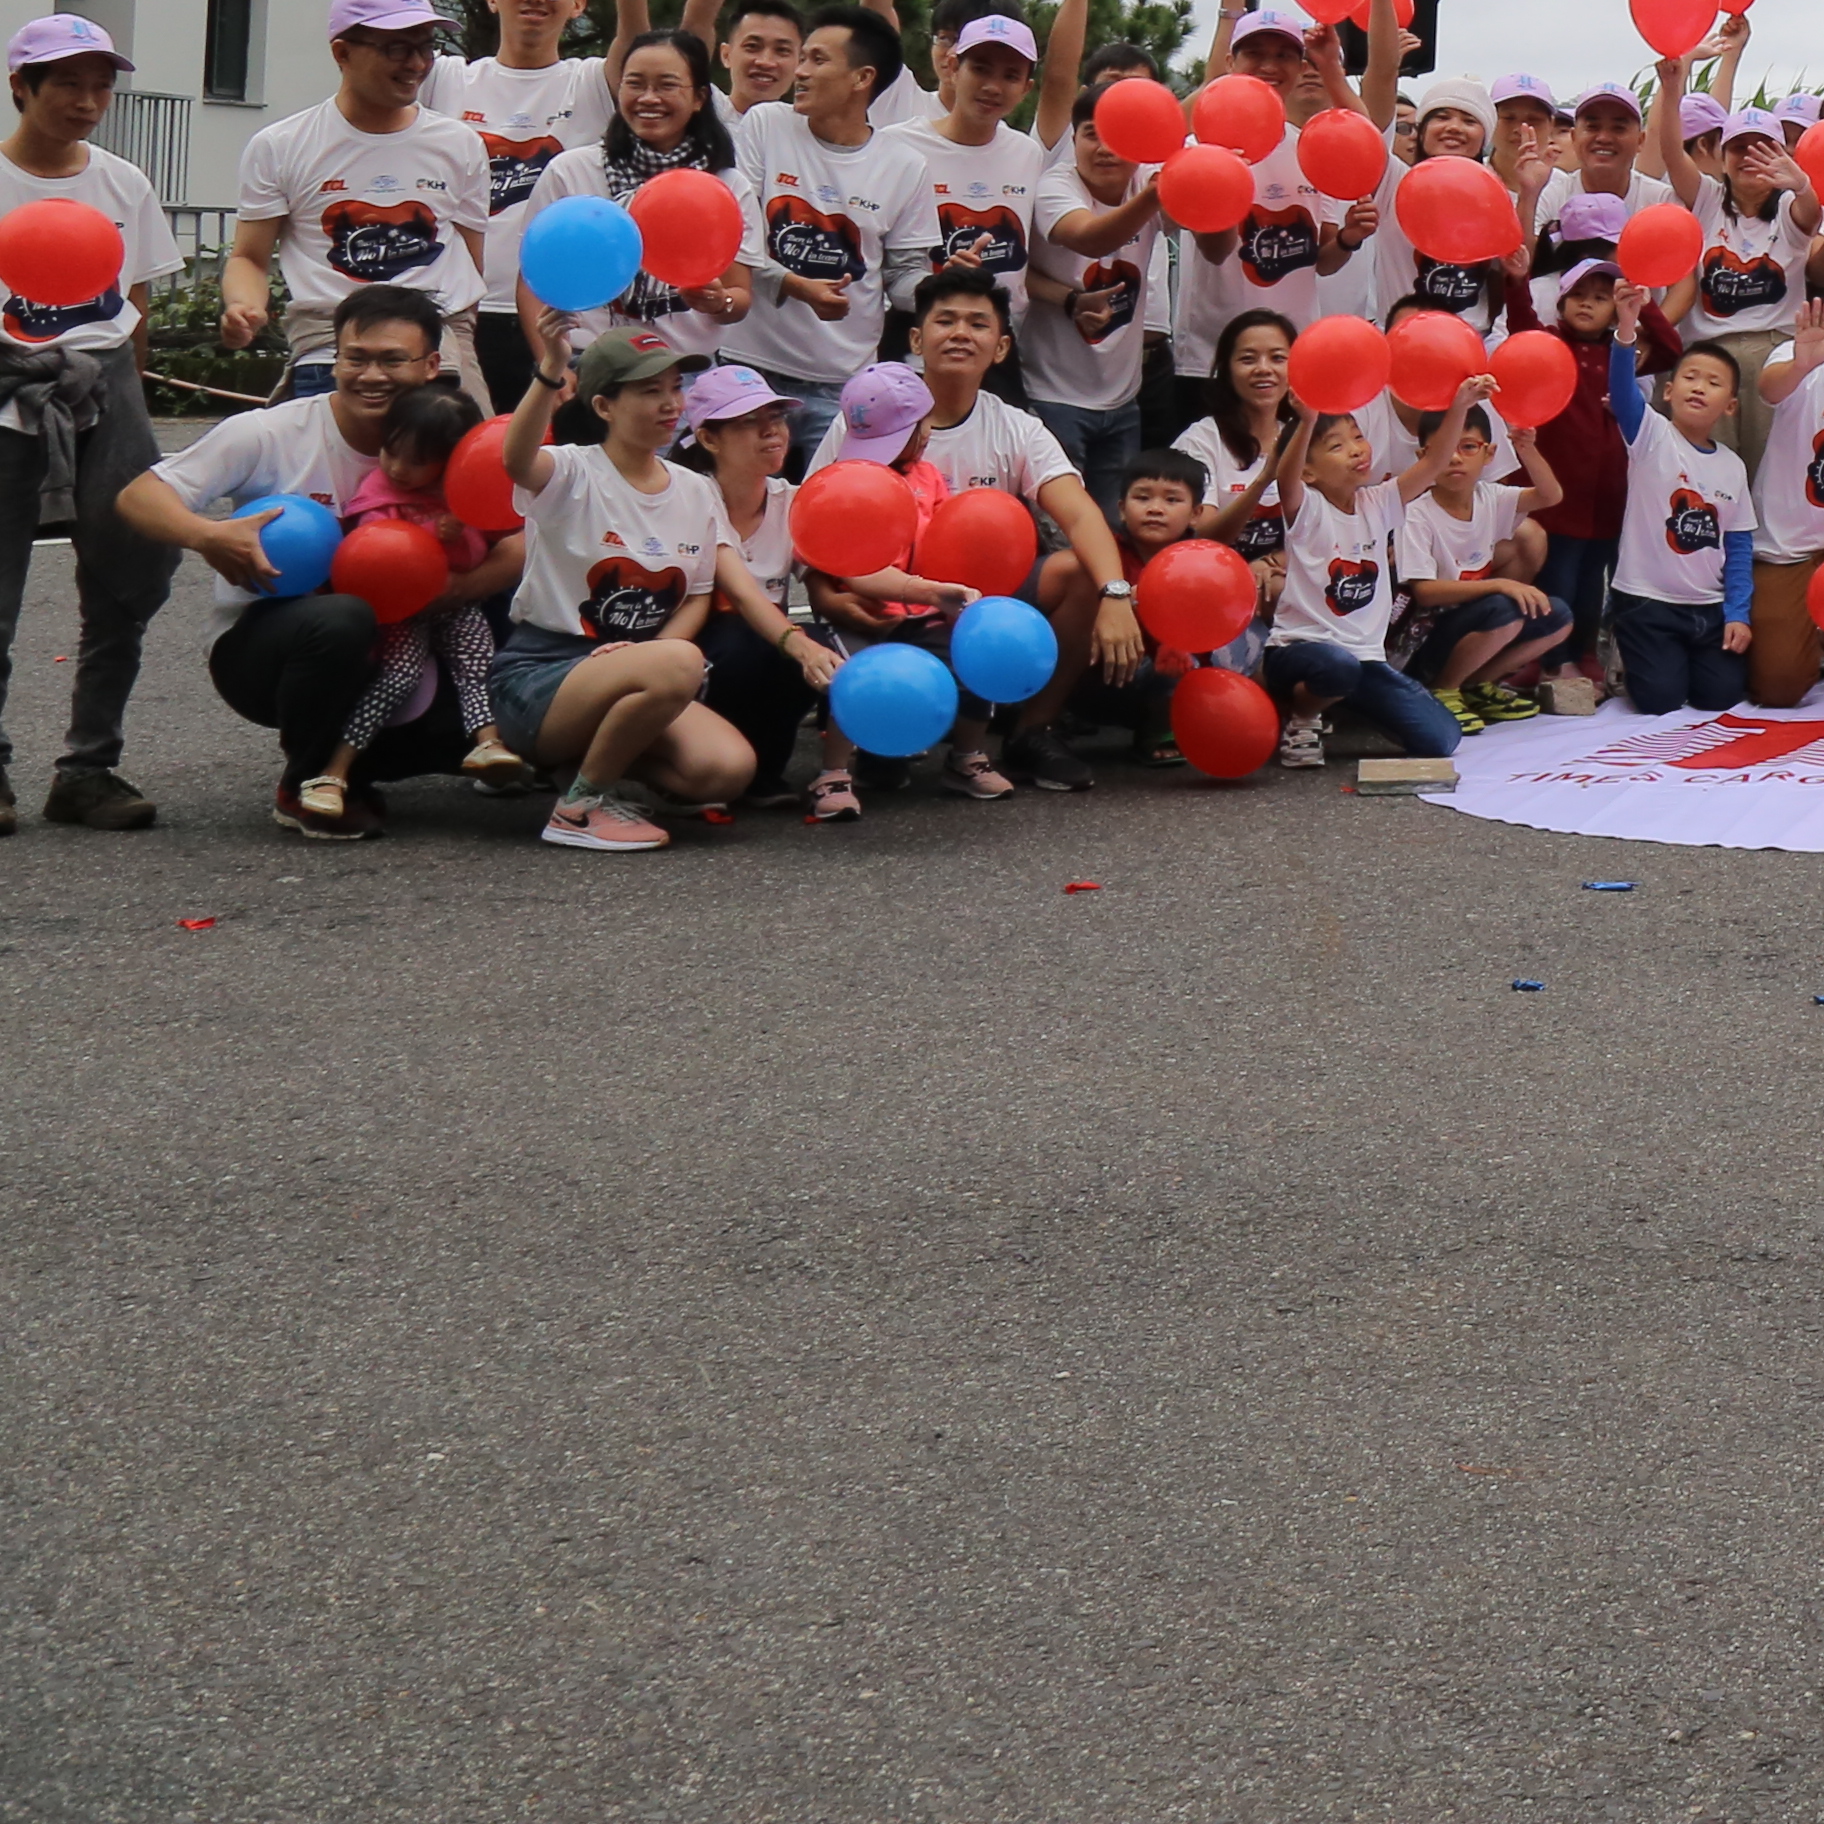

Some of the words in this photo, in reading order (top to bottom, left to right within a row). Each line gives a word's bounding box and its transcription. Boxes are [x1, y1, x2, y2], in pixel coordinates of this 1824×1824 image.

[860, 200, 880, 211] KHP
[609, 612, 626, 625] No
[1508, 770, 1665, 785] TIMES
